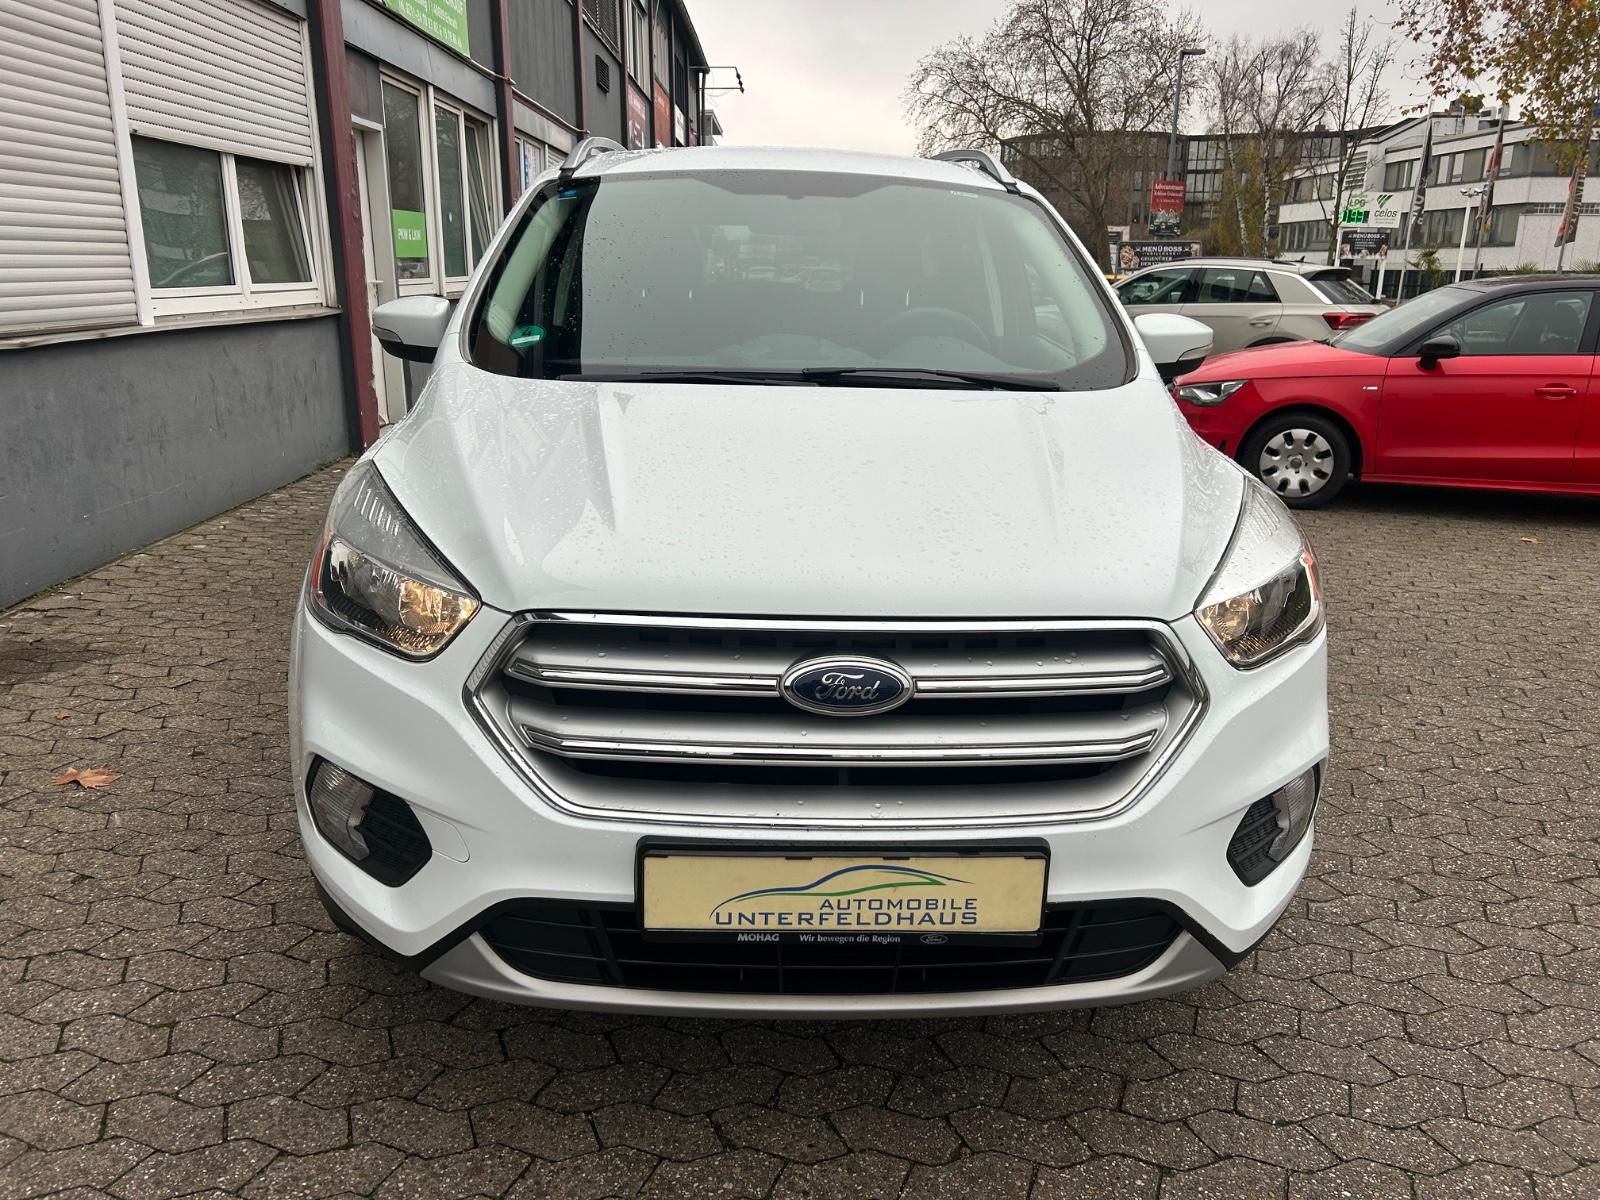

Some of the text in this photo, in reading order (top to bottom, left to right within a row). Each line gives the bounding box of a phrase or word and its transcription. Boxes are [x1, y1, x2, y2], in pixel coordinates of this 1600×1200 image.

[1374, 208, 1398, 218] celos
[815, 672, 881, 700] Ford
[819, 898, 978, 911] AUTOMOBILE
[715, 911, 978, 926] UNTERFELDHAUS
[737, 933, 780, 942] MOHAG
[799, 934, 815, 942] Wir
[817, 934, 855, 944] bewegen
[856, 934, 870, 943] die
[872, 934, 901, 945] Region
